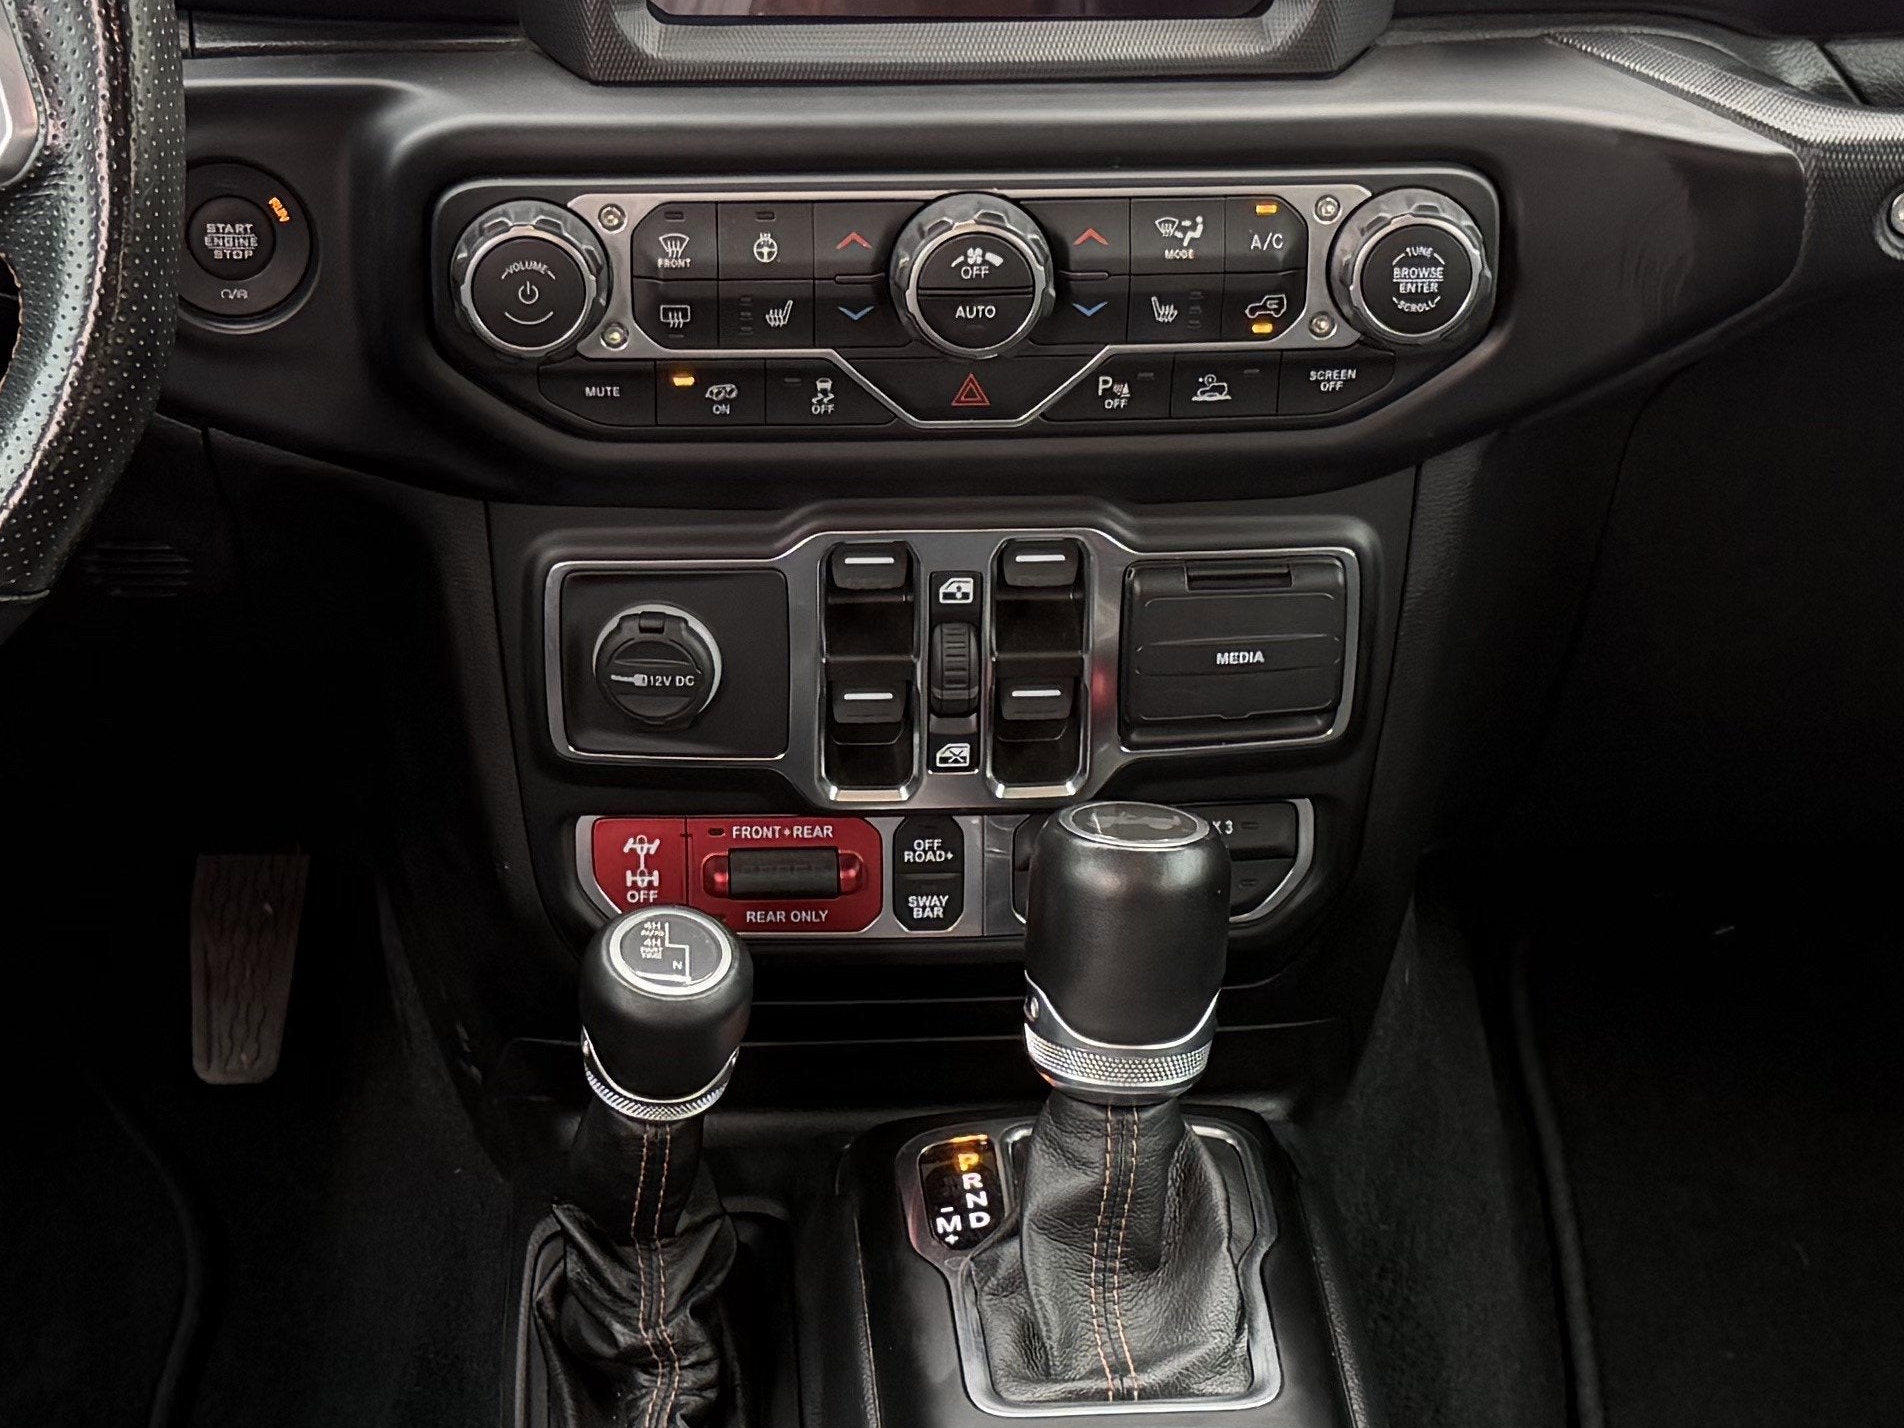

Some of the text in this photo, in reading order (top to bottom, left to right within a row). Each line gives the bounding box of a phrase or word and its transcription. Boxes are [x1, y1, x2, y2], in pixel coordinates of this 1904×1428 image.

[206, 223, 254, 234] START
[204, 236, 259, 247] ENGINE
[1249, 232, 1284, 252] A/C
[213, 249, 254, 260] STOP
[1164, 248, 1195, 261] MODE
[1405, 246, 1434, 259] TUNE
[507, 260, 548, 274] VOLUME
[656, 258, 692, 268] FRONT
[960, 266, 990, 280] OFF
[1392, 267, 1445, 280] BROWSE
[1398, 282, 1439, 294] ENTER
[955, 305, 997, 320] AUTO
[1397, 300, 1437, 314] SCROLL
[1309, 368, 1357, 381] SCREEN
[584, 386, 621, 398] MUTE
[1320, 381, 1344, 392] OFF
[712, 404, 731, 415] ON
[811, 403, 835, 415] OFF
[1104, 398, 1129, 410] OFF
[1216, 650, 1266, 665] MEDIA
[650, 675, 696, 687] 12V DC
[1224, 820, 1234, 835] 3
[913, 839, 943, 851] OFF
[626, 891, 659, 904] OFF
[907, 895, 949, 908] SWAY
[746, 909, 829, 923] REAR ONLY
[913, 907, 944, 919] BAR
[643, 921, 662, 931] 4H
[643, 938, 662, 948] 4H
[672, 960, 684, 971] N
[957, 1152, 980, 1172] P
[962, 1172, 984, 1190] R
[965, 1190, 989, 1209] N
[936, 1214, 963, 1234] M
[968, 1211, 991, 1229] D
